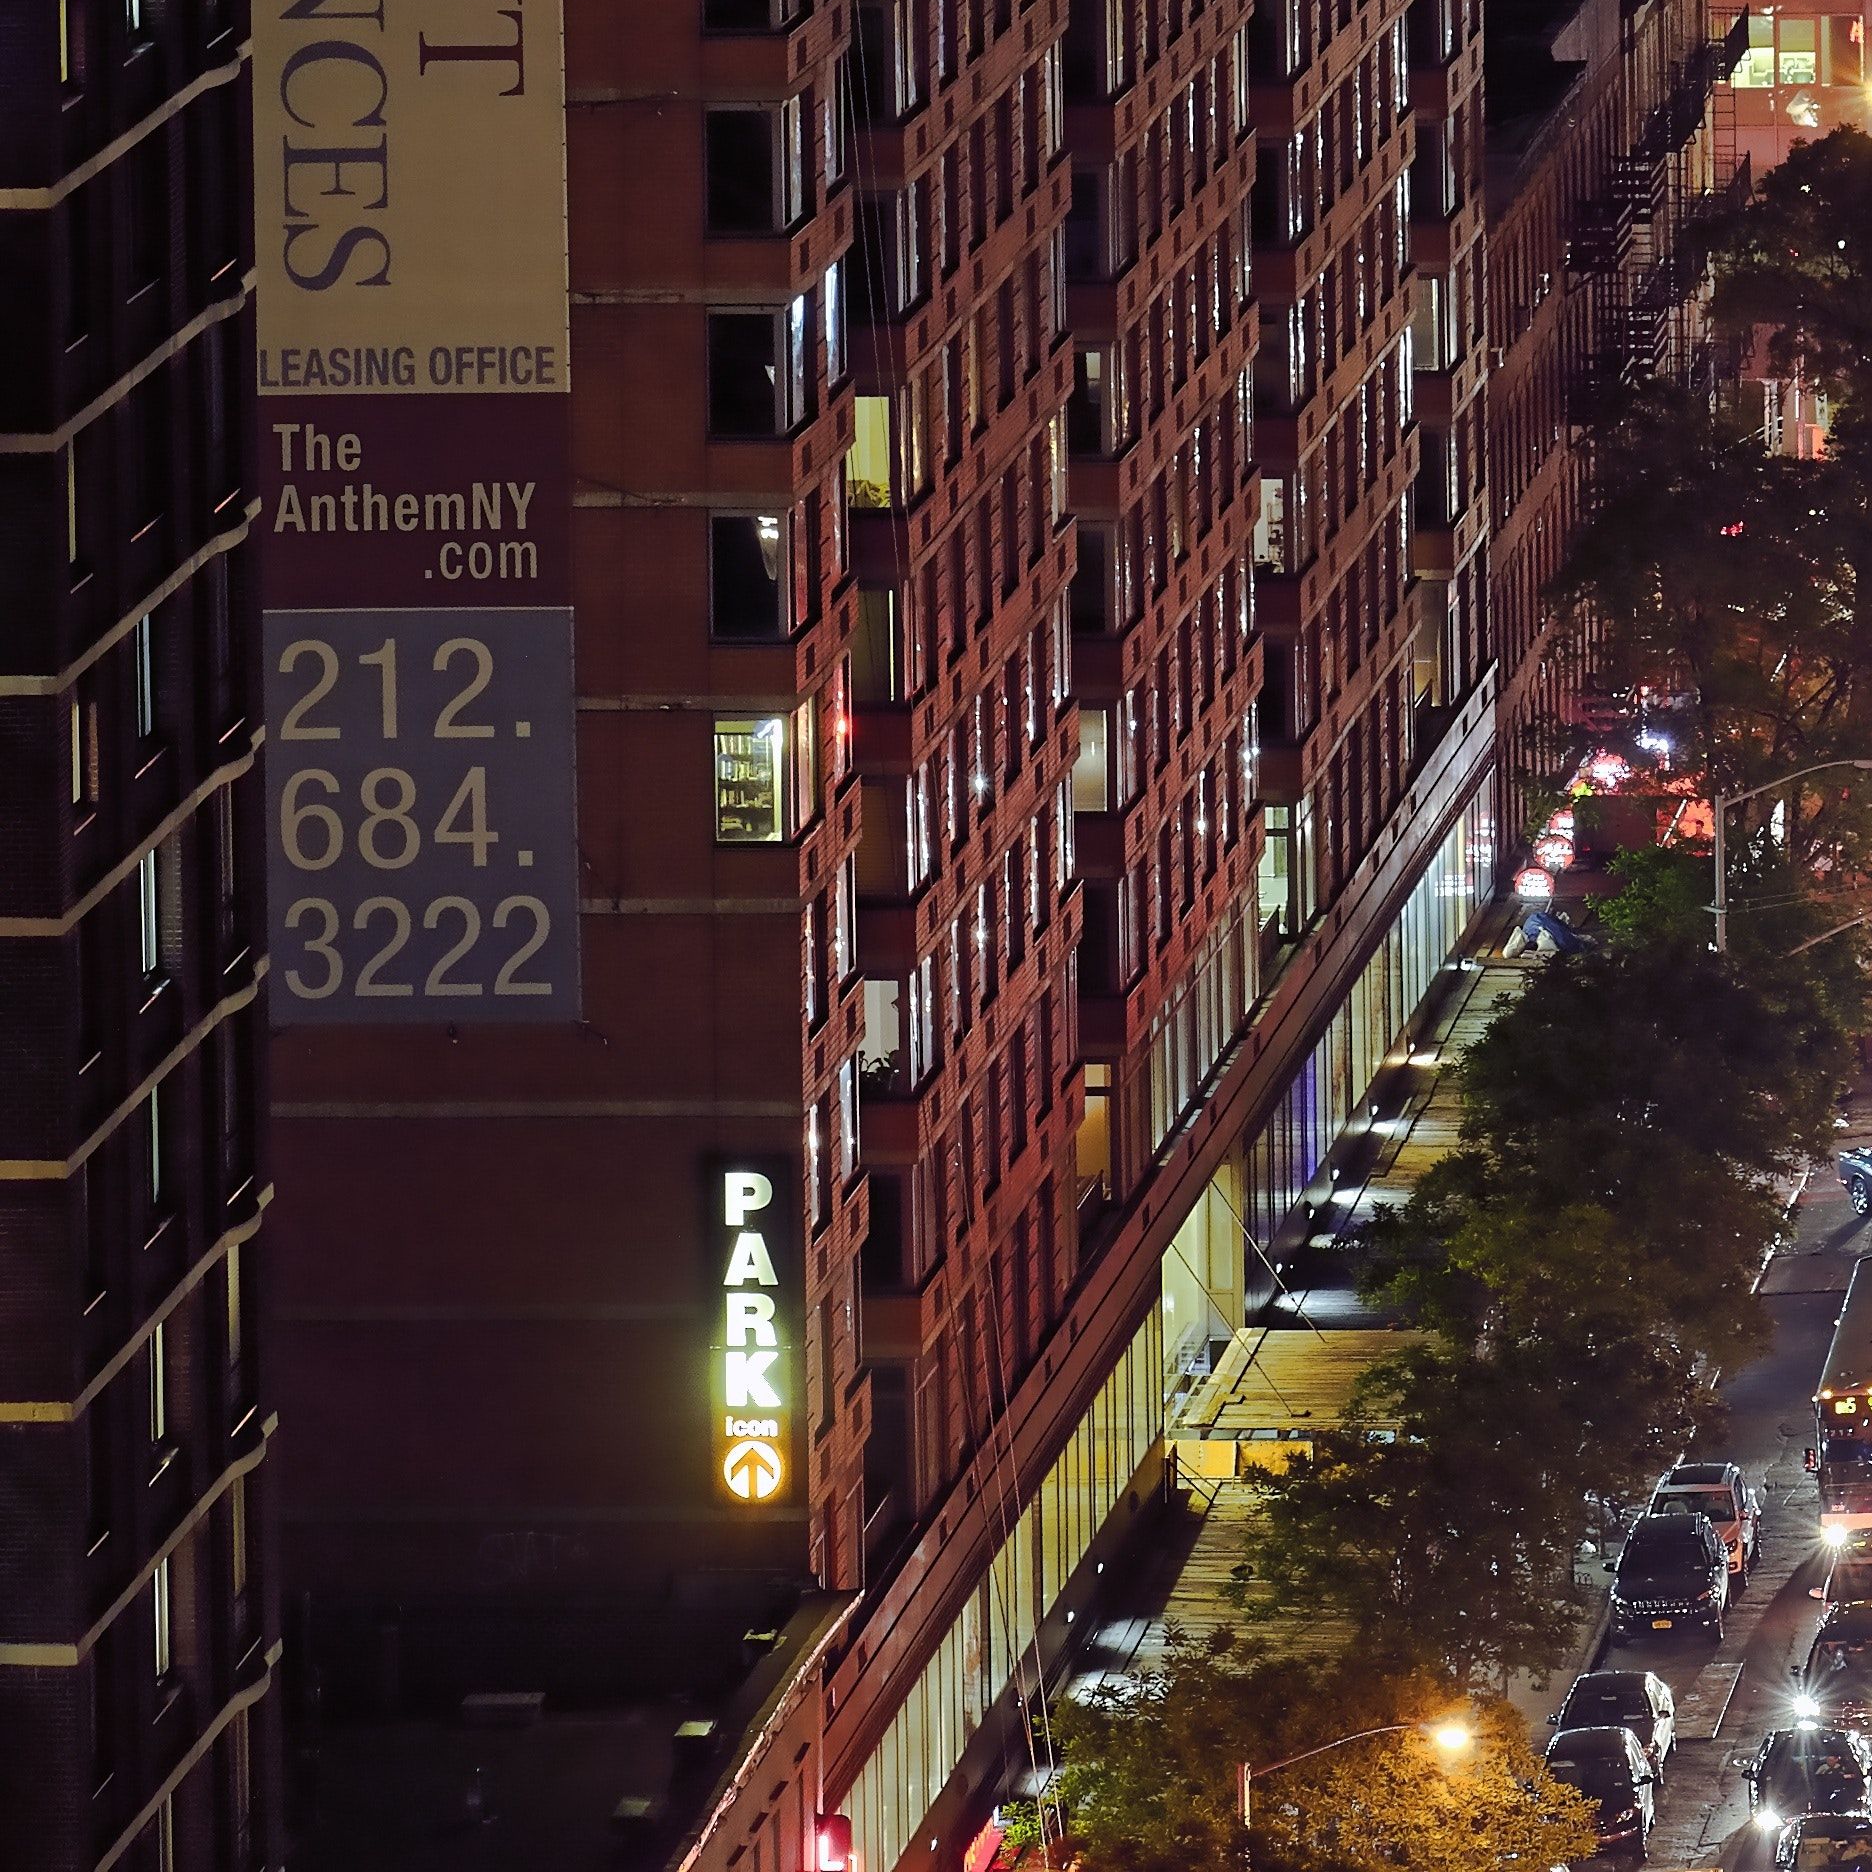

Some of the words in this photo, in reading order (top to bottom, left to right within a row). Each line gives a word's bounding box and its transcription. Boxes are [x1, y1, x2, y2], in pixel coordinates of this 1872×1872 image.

[258, 346, 416, 388] LEASING
[428, 345, 556, 386] OFFICE
[272, 422, 362, 472] The
[273, 481, 537, 533] AnthemNY
[424, 540, 539, 580] .com
[278, 637, 532, 741] 212.
[279, 765, 534, 871] 684.
[284, 894, 553, 1000] 3222
[723, 1172, 782, 1408] PARK
[724, 1415, 779, 1438] icon
